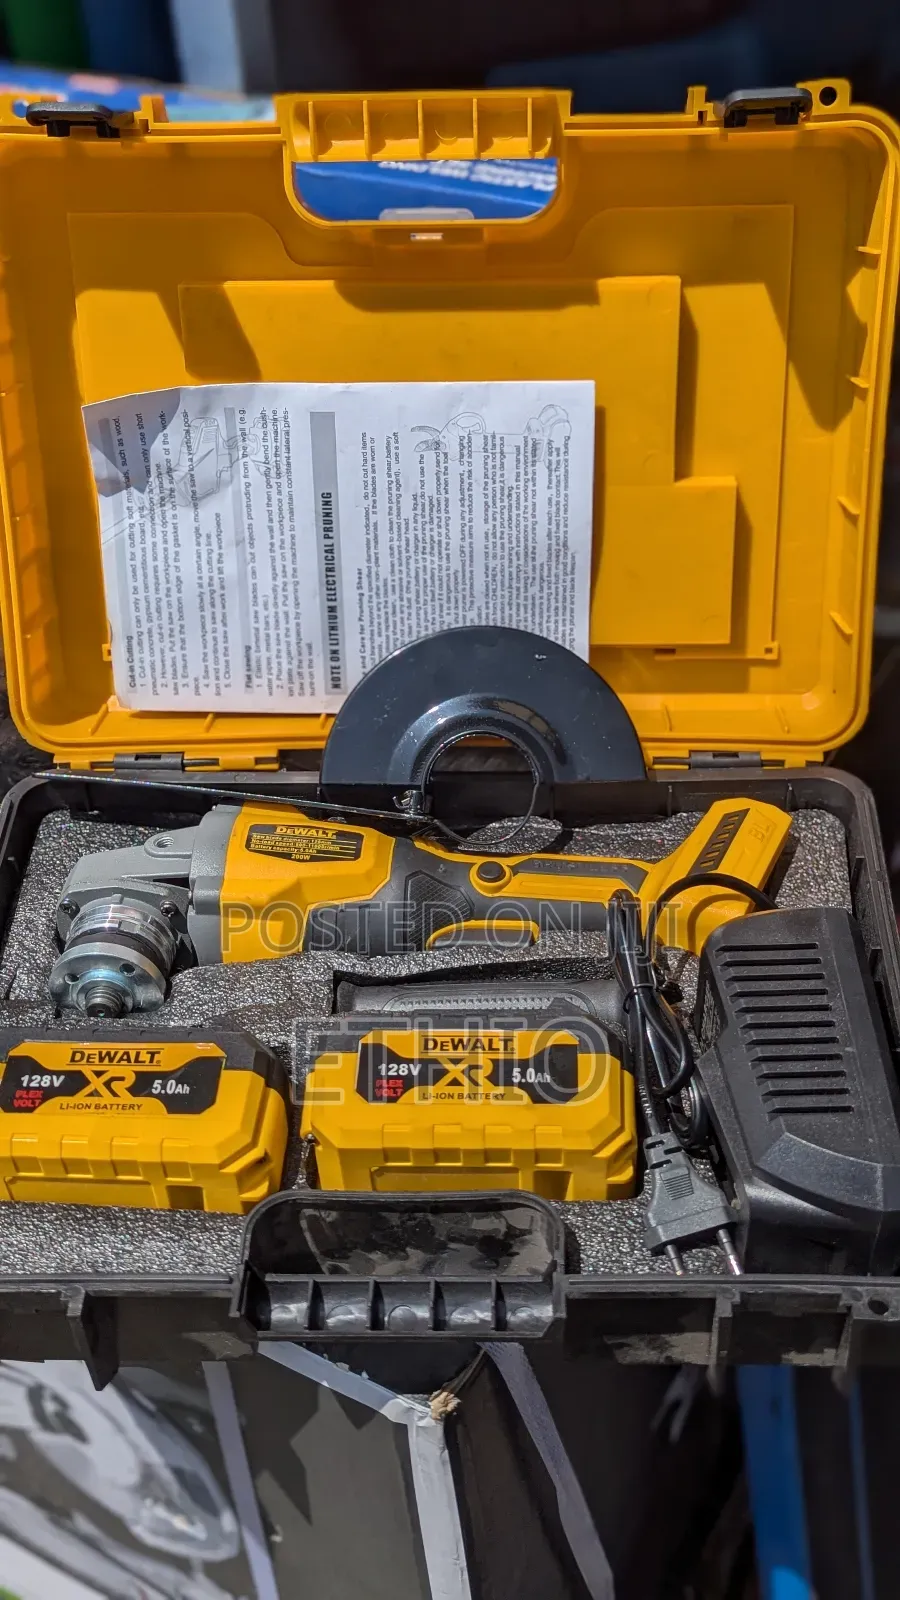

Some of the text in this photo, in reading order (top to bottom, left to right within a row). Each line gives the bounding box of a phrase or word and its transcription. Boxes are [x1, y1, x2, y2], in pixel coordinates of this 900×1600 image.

[321, 492, 341, 689] NOTE ON LITHIUM ELECTRICAL PRUNING
[126, 636, 136, 688] Cut-in Cutting
[422, 1037, 512, 1052] DEWALT
[70, 1050, 156, 1064] DEWALT
[378, 1064, 422, 1076] 128V
[434, 1056, 495, 1086] XR
[512, 1068, 550, 1083] 5.0Ah
[20, 1075, 65, 1088] 128V
[73, 1068, 136, 1097] XR
[151, 1080, 190, 1094] 5.0Ah
[375, 1089, 403, 1097] VOLT
[422, 1092, 506, 1100] LI-ION BATTERY
[13, 1099, 41, 1108] VOLT
[94, 1103, 143, 1111] BATTERY
